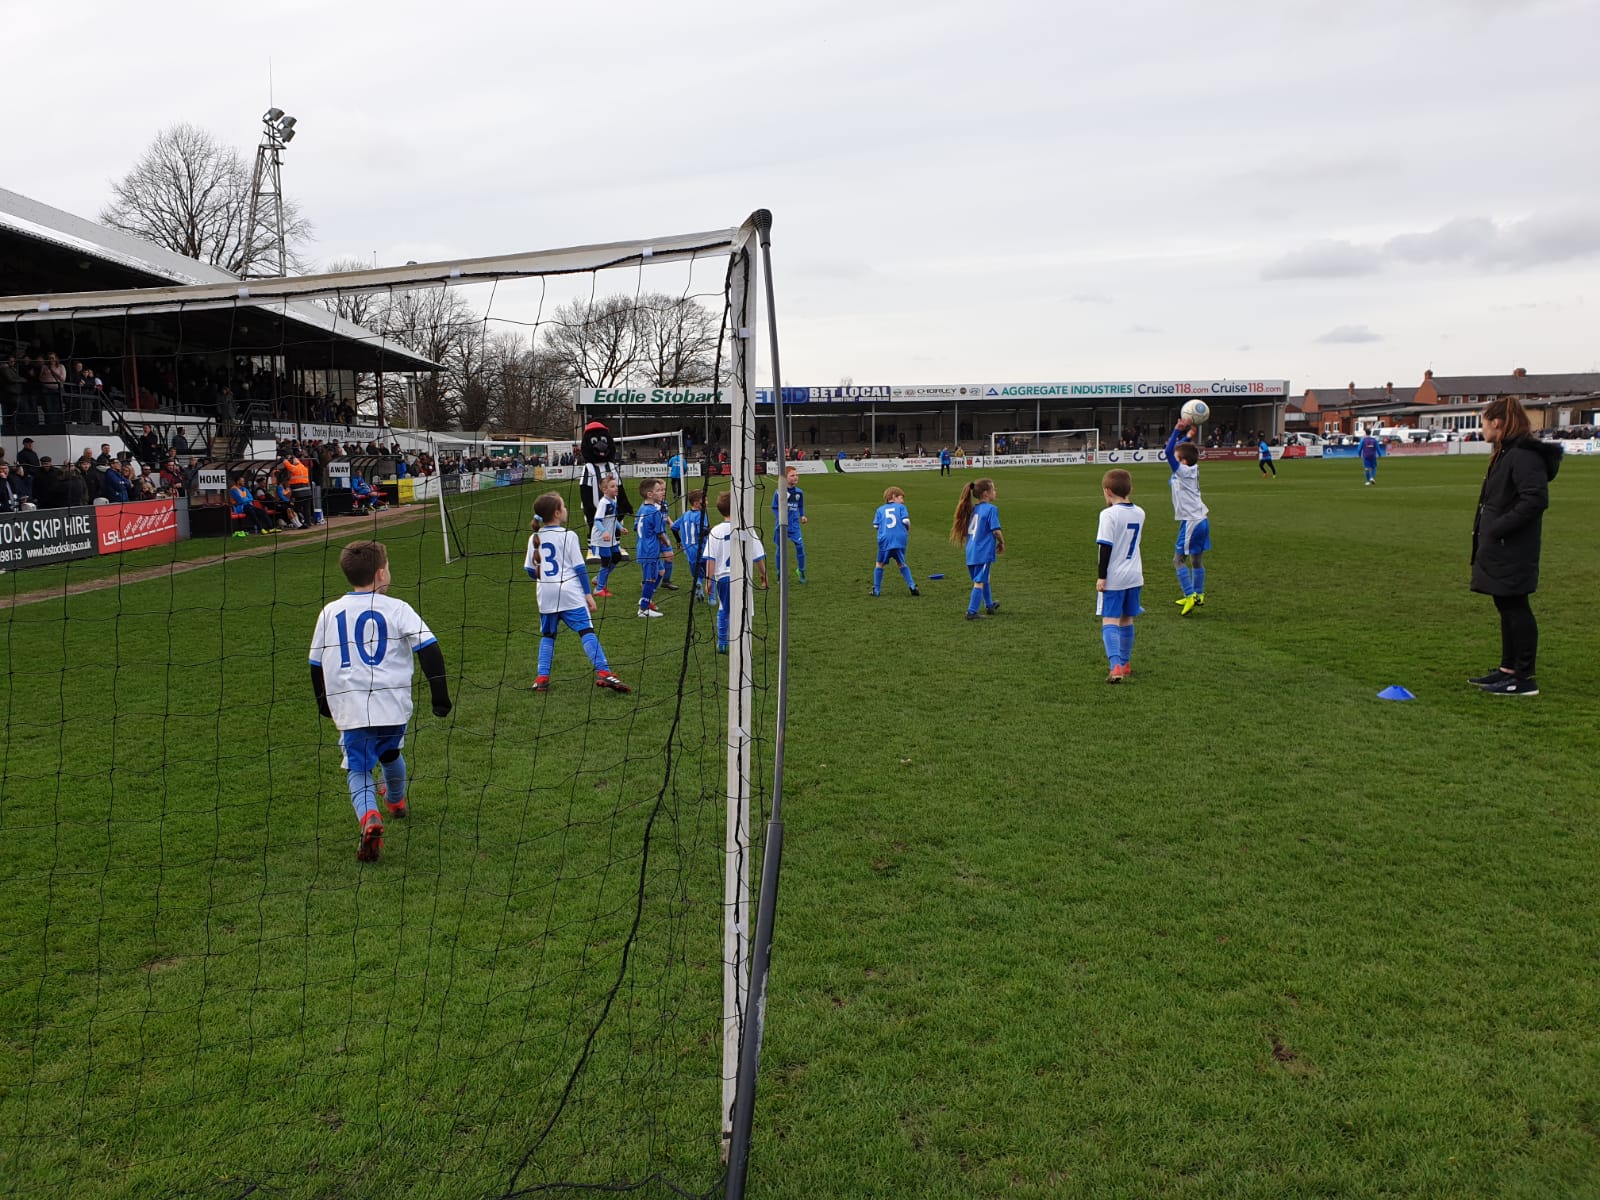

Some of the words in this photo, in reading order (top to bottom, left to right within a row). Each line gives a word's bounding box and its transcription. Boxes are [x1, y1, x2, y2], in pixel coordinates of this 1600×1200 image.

[594, 389, 646, 403] Eddie
[650, 389, 723, 403] Stobart
[809, 387, 838, 398] BET
[842, 386, 890, 398] LOCAL
[1001, 386, 1069, 396] AGGREGATE
[1071, 384, 1133, 395] INDUSTRIES
[1138, 383, 1209, 394] Cruise118.com
[1211, 382, 1281, 393] Cruise118.com
[200, 475, 226, 484] HOME
[0, 521, 30, 544] TOCK
[32, 518, 61, 540] SKIP
[64, 514, 91, 537] HIRE
[885, 507, 897, 529] 5
[968, 513, 979, 538] 4
[684, 520, 696, 545] 11
[1126, 523, 1140, 560] 7
[541, 542, 559, 577] 3
[336, 608, 388, 669] 10
